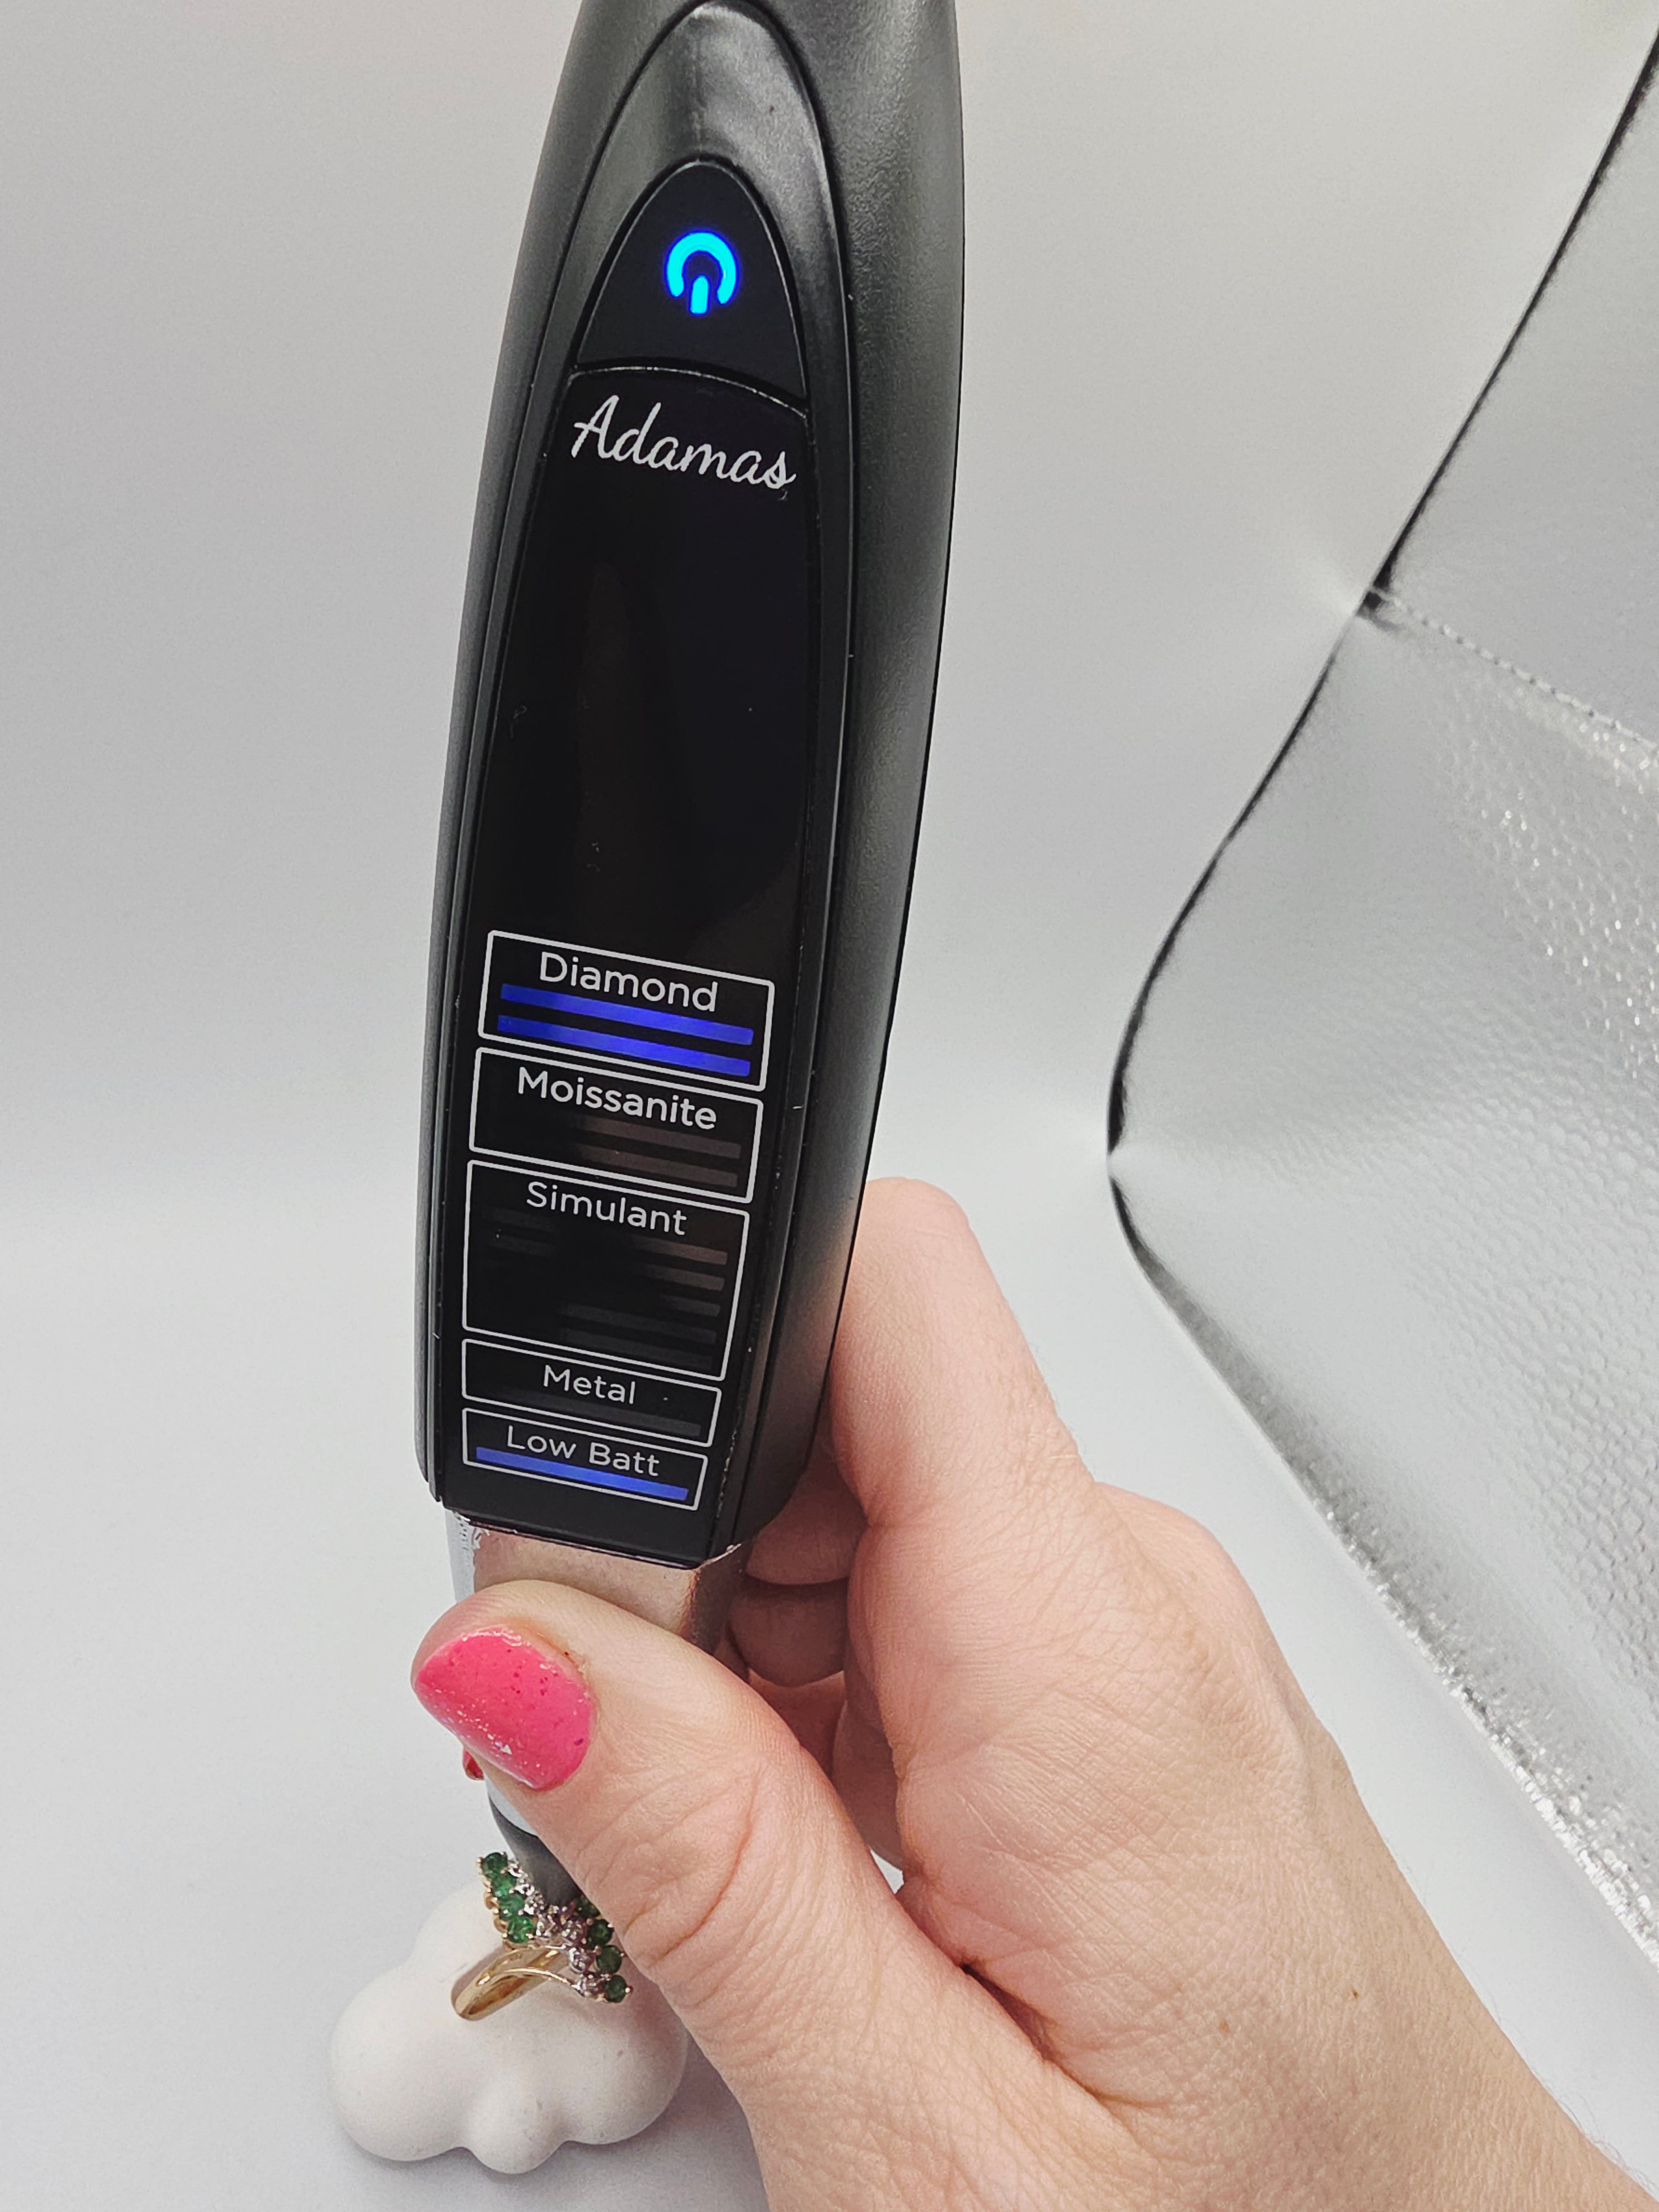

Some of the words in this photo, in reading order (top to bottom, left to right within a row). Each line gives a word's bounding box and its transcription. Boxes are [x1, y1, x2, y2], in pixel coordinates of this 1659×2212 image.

[571, 394, 797, 489] Adamas
[539, 951, 718, 1012] Diamond
[518, 1066, 717, 1130] Moissanite
[526, 1181, 687, 1235] Simulant
[542, 1364, 636, 1405] Metal
[507, 1425, 577, 1459] Low
[589, 1442, 660, 1477] Batt
